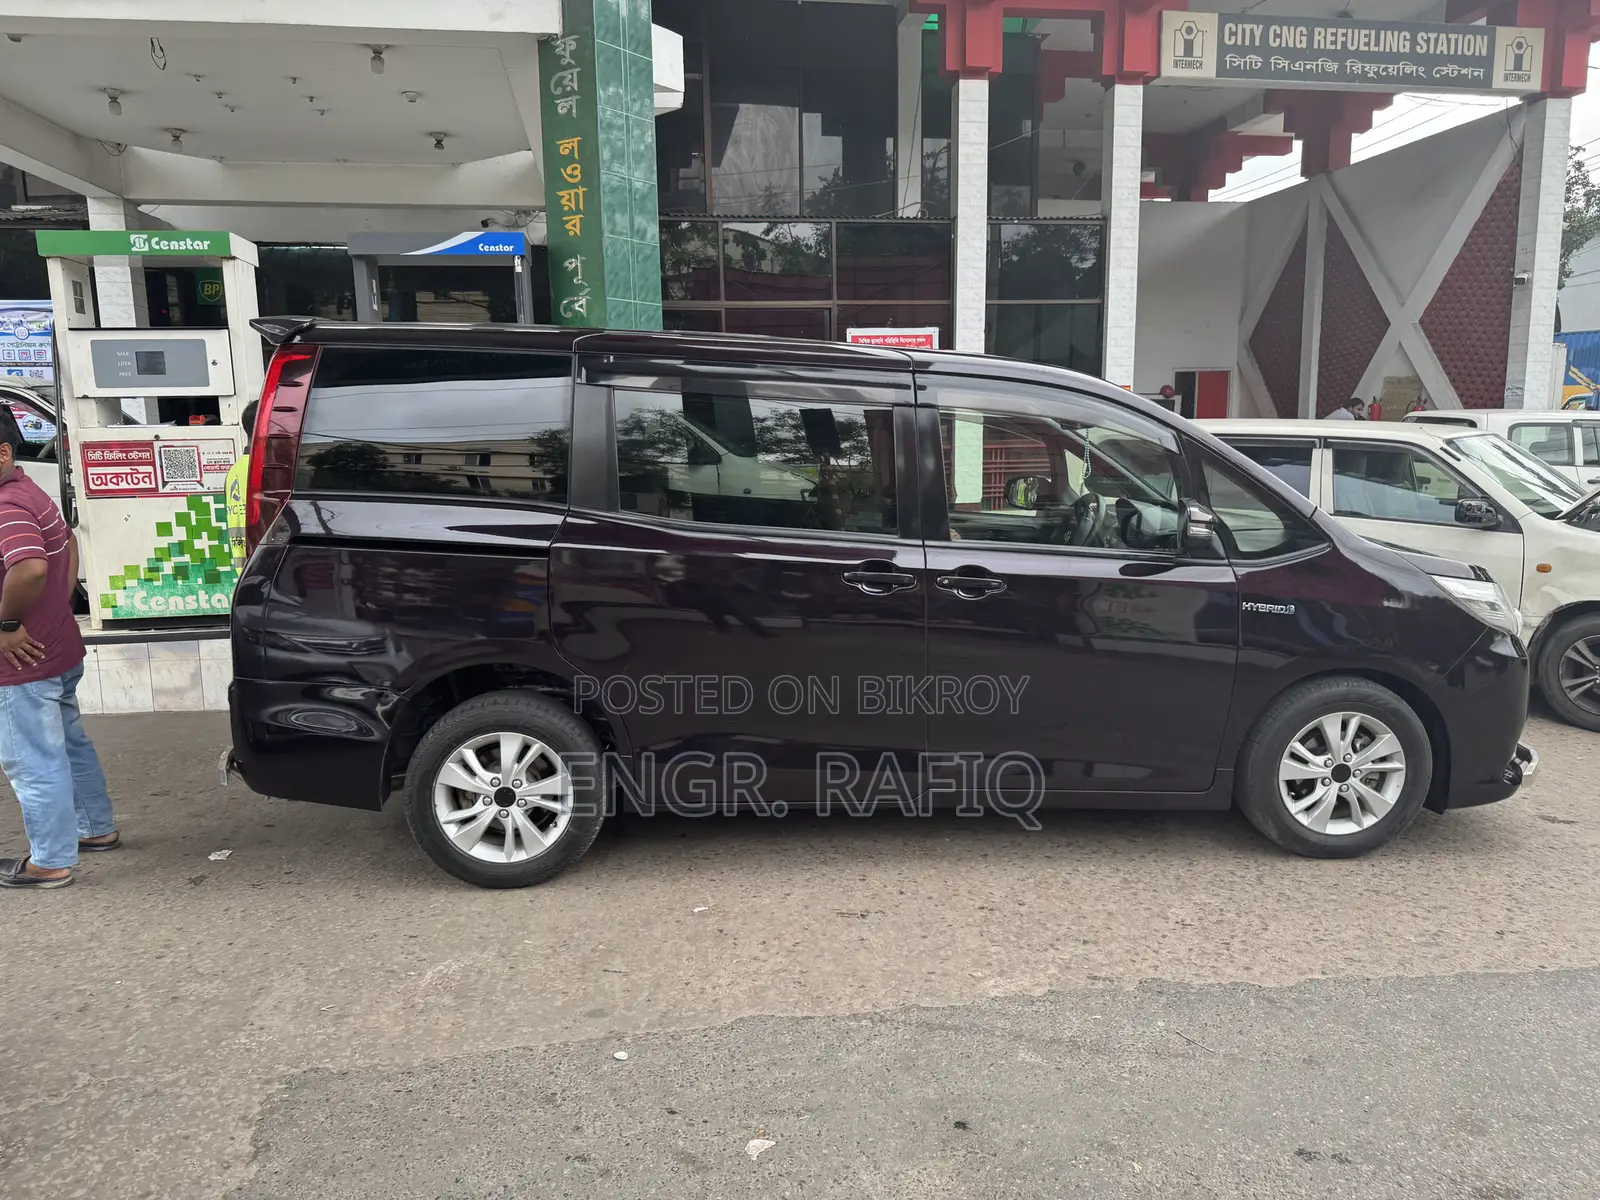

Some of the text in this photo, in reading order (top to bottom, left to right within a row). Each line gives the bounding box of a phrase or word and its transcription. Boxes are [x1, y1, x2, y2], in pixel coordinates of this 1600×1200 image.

[1224, 23, 1488, 57] CITY CNG REFUELING STATION
[1173, 59, 1204, 70] INTERMECH
[1224, 53, 1485, 80] সিটি সিএনজি রিফুয়েলিং স্টেশন
[1503, 72, 1531, 83] INTERMECH
[151, 237, 211, 250] Censtar
[478, 243, 514, 252] Censtar
[204, 284, 220, 295] BP
[87, 450, 150, 460] সিটি ফিলিং স্টেশন
[90, 468, 153, 487] অকটেন
[133, 590, 233, 611] Censta
[1242, 602, 1286, 614] HYBRID
